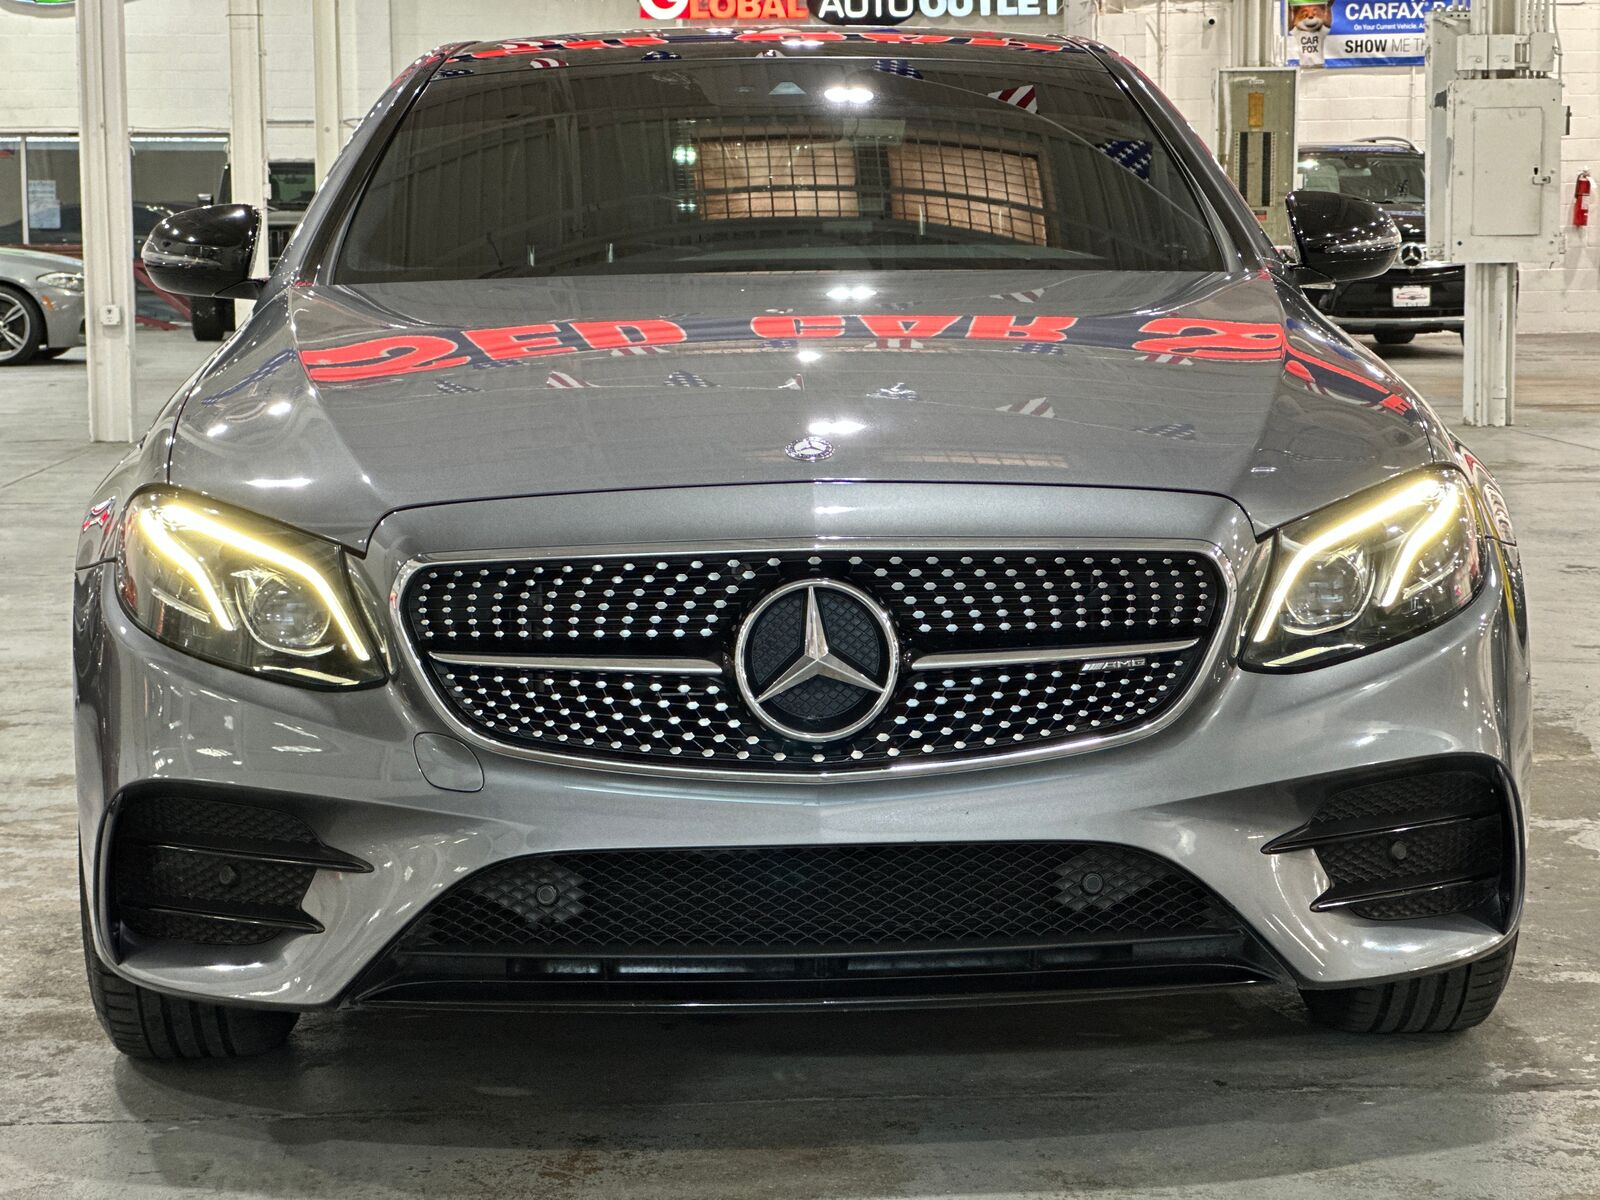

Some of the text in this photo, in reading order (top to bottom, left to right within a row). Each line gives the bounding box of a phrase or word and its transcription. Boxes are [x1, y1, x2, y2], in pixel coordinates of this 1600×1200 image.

[1345, 2, 1425, 20] CARFAX
[1300, 36, 1319, 45] CAR
[1345, 39, 1388, 53] SHOW
[1391, 38, 1410, 52] ME
[1302, 45, 1319, 53] FOX
